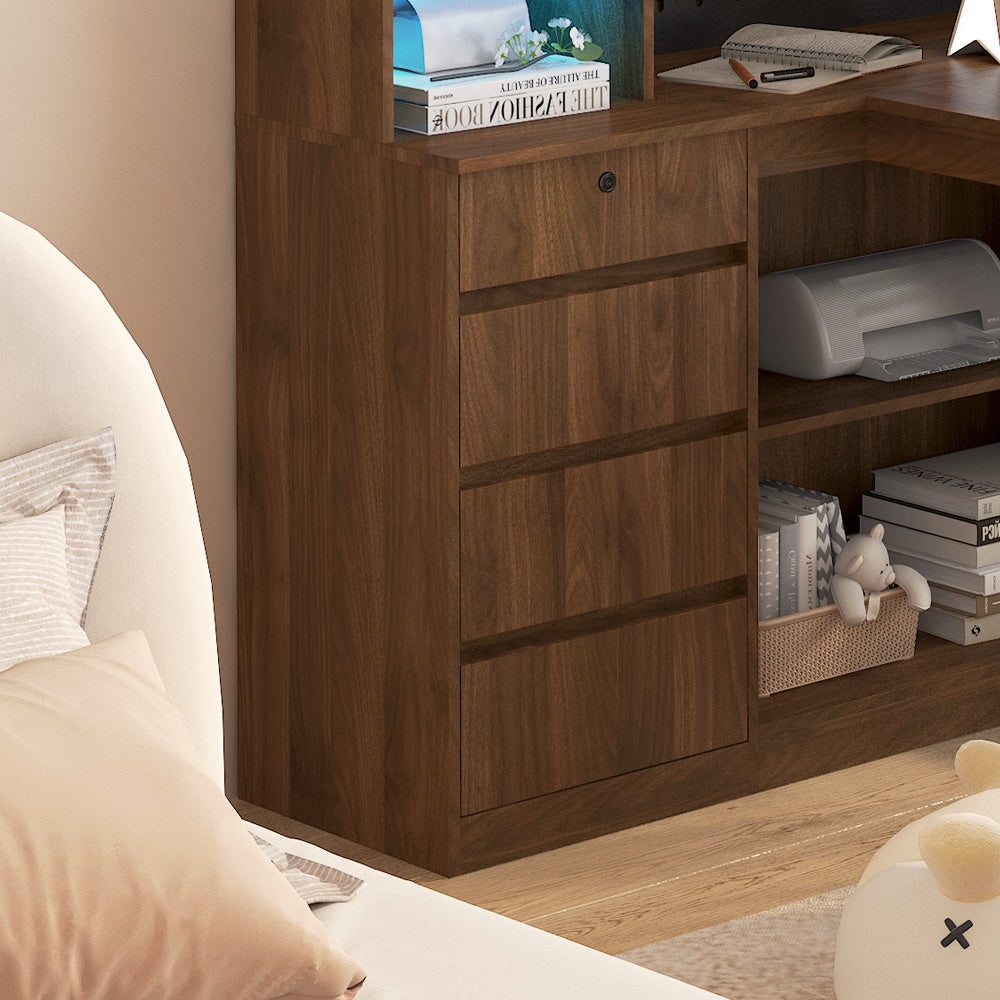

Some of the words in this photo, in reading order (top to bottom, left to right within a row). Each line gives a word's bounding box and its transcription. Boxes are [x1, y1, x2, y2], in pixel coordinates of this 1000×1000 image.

[551, 72, 580, 85] ALLURE
[583, 69, 600, 80] THE
[500, 79, 534, 92] BEAUTY
[535, 78, 548, 87] OF
[982, 520, 1000, 541] РЭЙ
